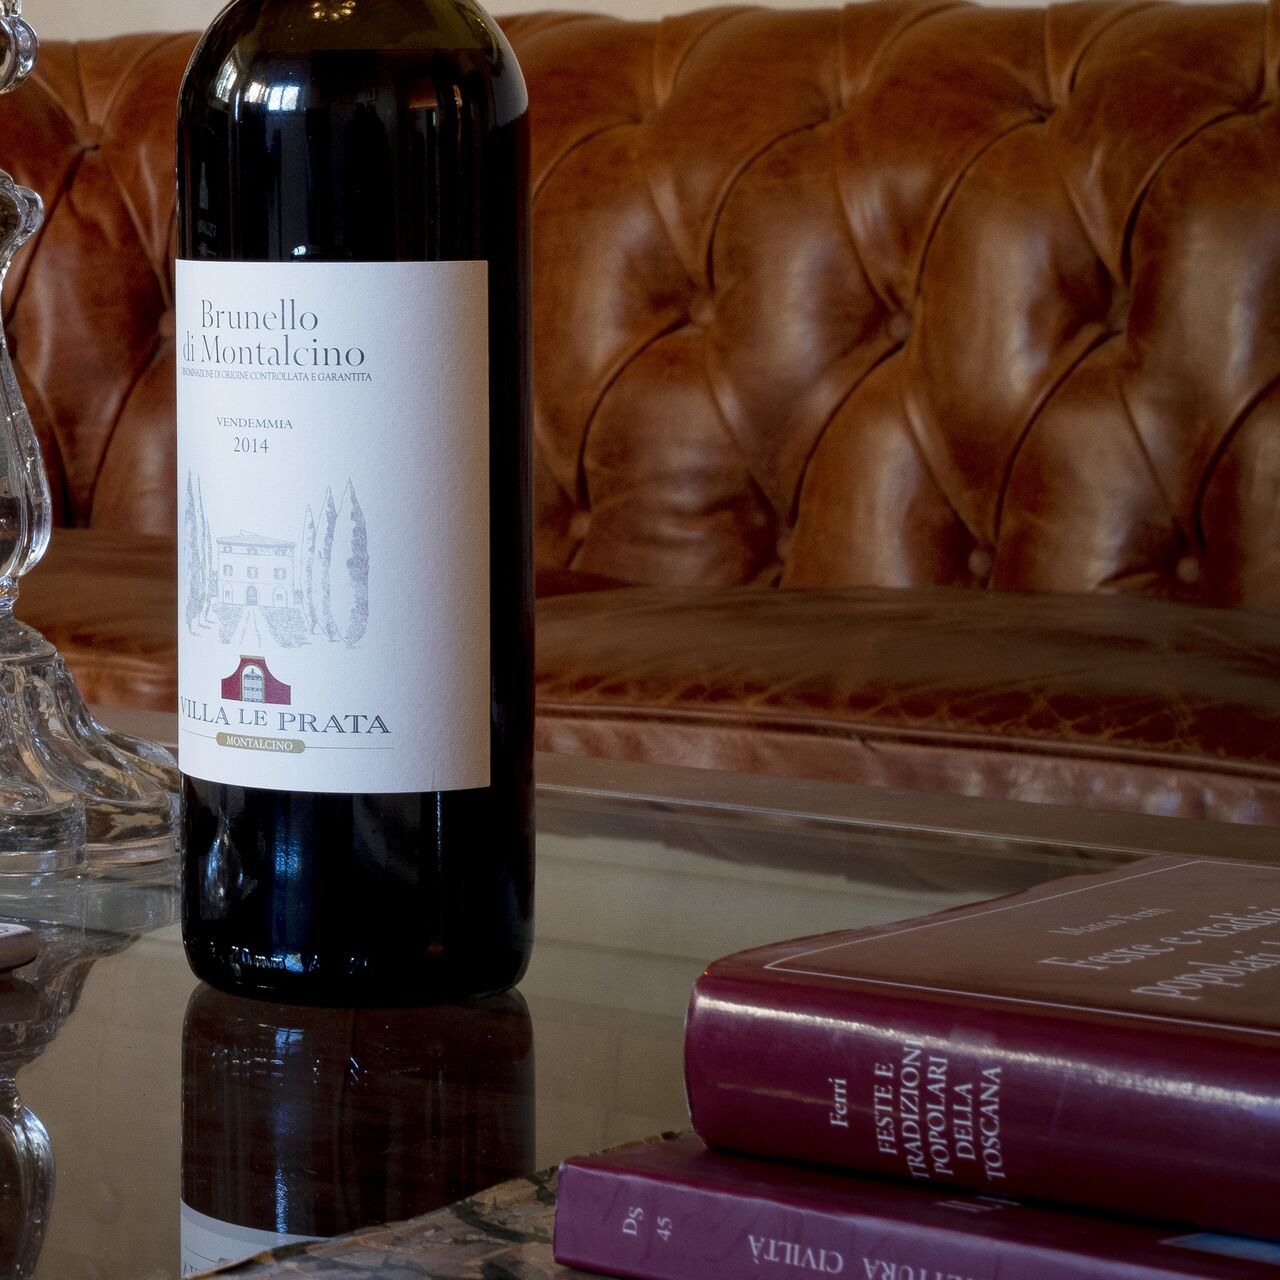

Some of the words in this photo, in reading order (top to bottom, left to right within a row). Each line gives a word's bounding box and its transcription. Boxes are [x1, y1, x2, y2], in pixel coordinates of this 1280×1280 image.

[201, 299, 318, 330] Brunello
[183, 331, 195, 362] di
[202, 334, 365, 366] Montalcino
[222, 371, 249, 379] ORIGINE
[250, 372, 309, 381] CONTROLLATA
[311, 373, 316, 381] E
[318, 373, 372, 382] GARANTITA
[216, 416, 293, 429] VENDEMMIA
[233, 437, 269, 453] 2014
[181, 696, 230, 725] VILLA
[239, 708, 268, 726] LE
[279, 712, 391, 734] PRATA
[227, 735, 293, 751] MONTALCINO
[1038, 944, 1175, 969] Feste
[1160, 937, 1202, 945] e
[875, 1063, 893, 1077] E
[829, 1077, 848, 1127] Ferri
[874, 1085, 898, 1155] FESTE
[900, 1039, 929, 1178] TRADIZIONI
[927, 1056, 953, 1175] POPOLARI
[953, 1084, 976, 1160] DELLA
[980, 1066, 1006, 1179] TOSCANA
[747, 1234, 844, 1274] CIVILTÀ
